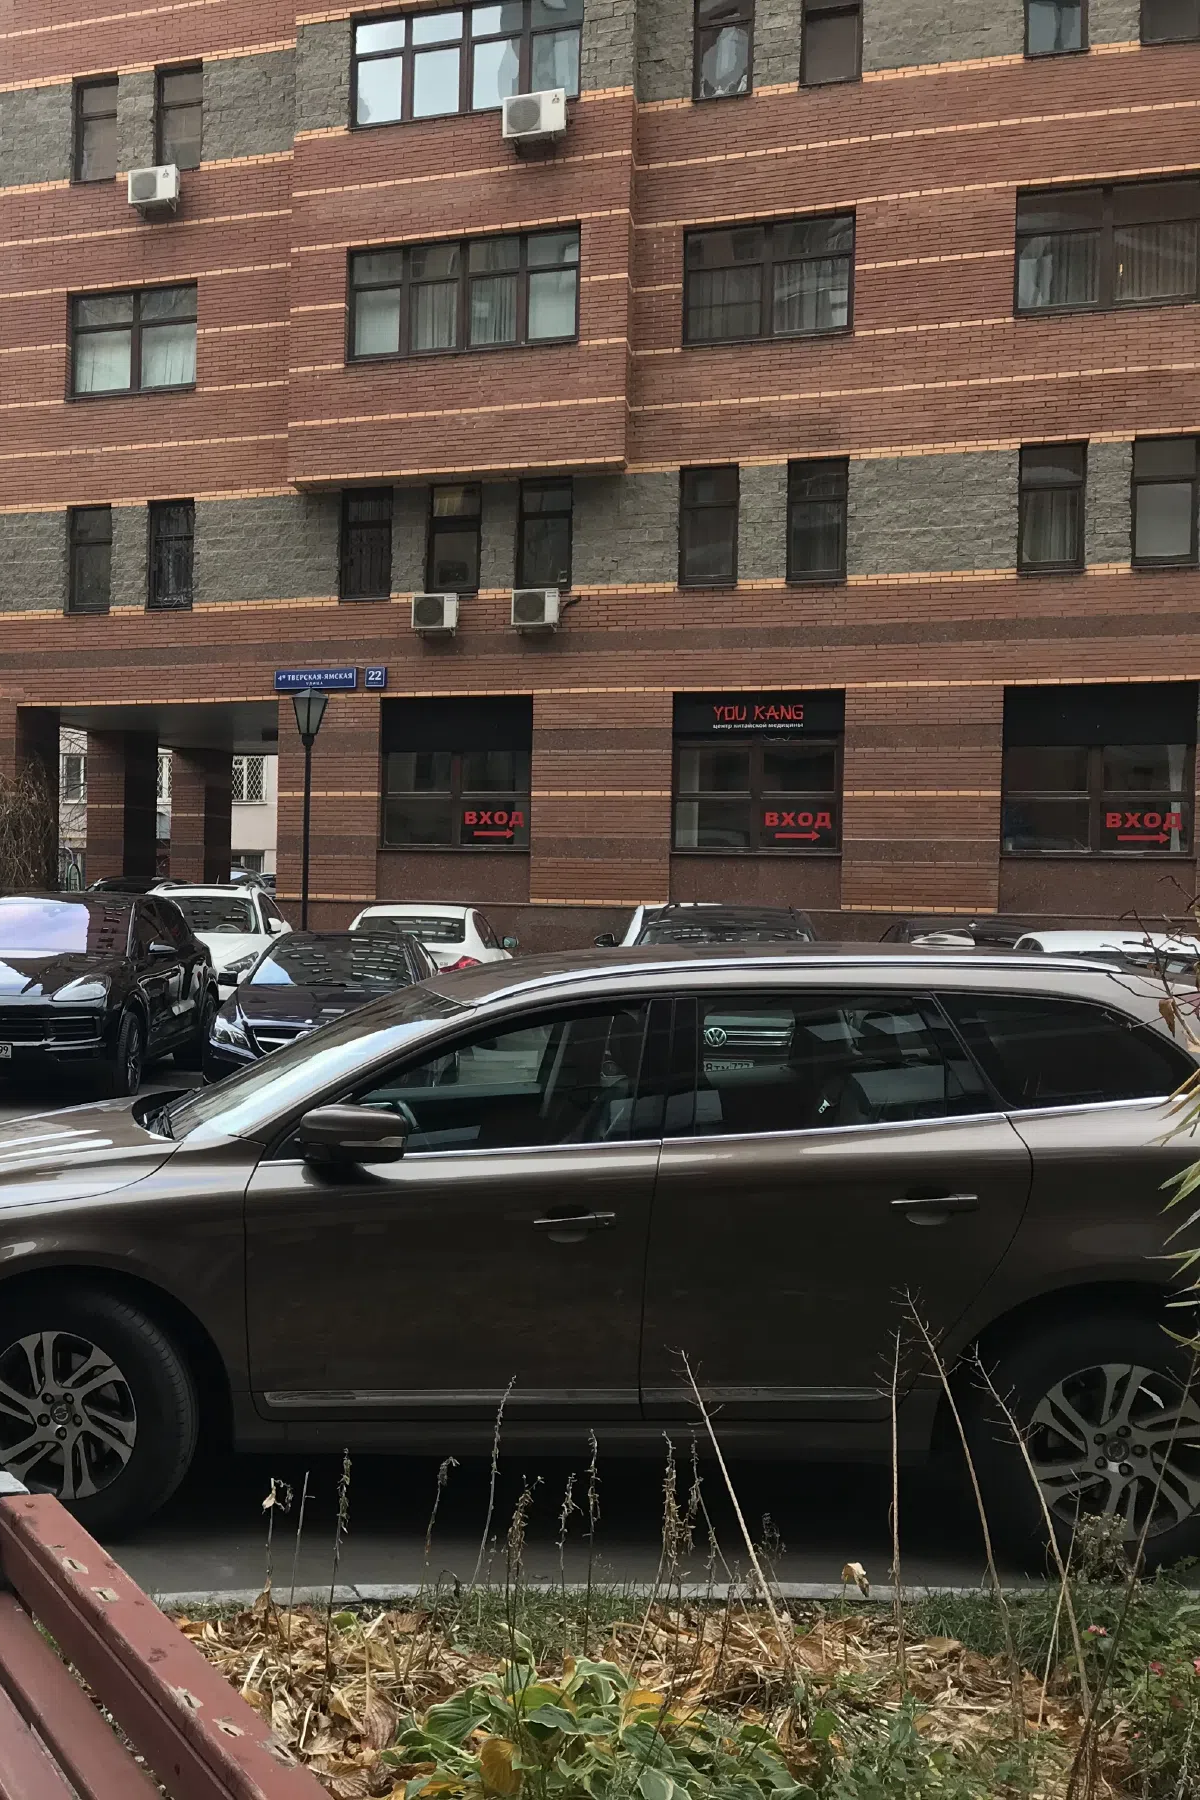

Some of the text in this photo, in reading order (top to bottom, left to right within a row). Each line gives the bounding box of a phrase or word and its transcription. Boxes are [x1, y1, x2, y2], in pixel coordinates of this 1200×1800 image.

[288, 672, 353, 681] ТВЕРСКАЯ-ЯМСКАЯ
[368, 670, 382, 681] 22
[713, 704, 804, 721] YOU KANG
[733, 721, 767, 729] китайской
[464, 811, 525, 828] ВХОД
[764, 811, 832, 829] ВХОД
[1105, 812, 1183, 831] ВХОД
